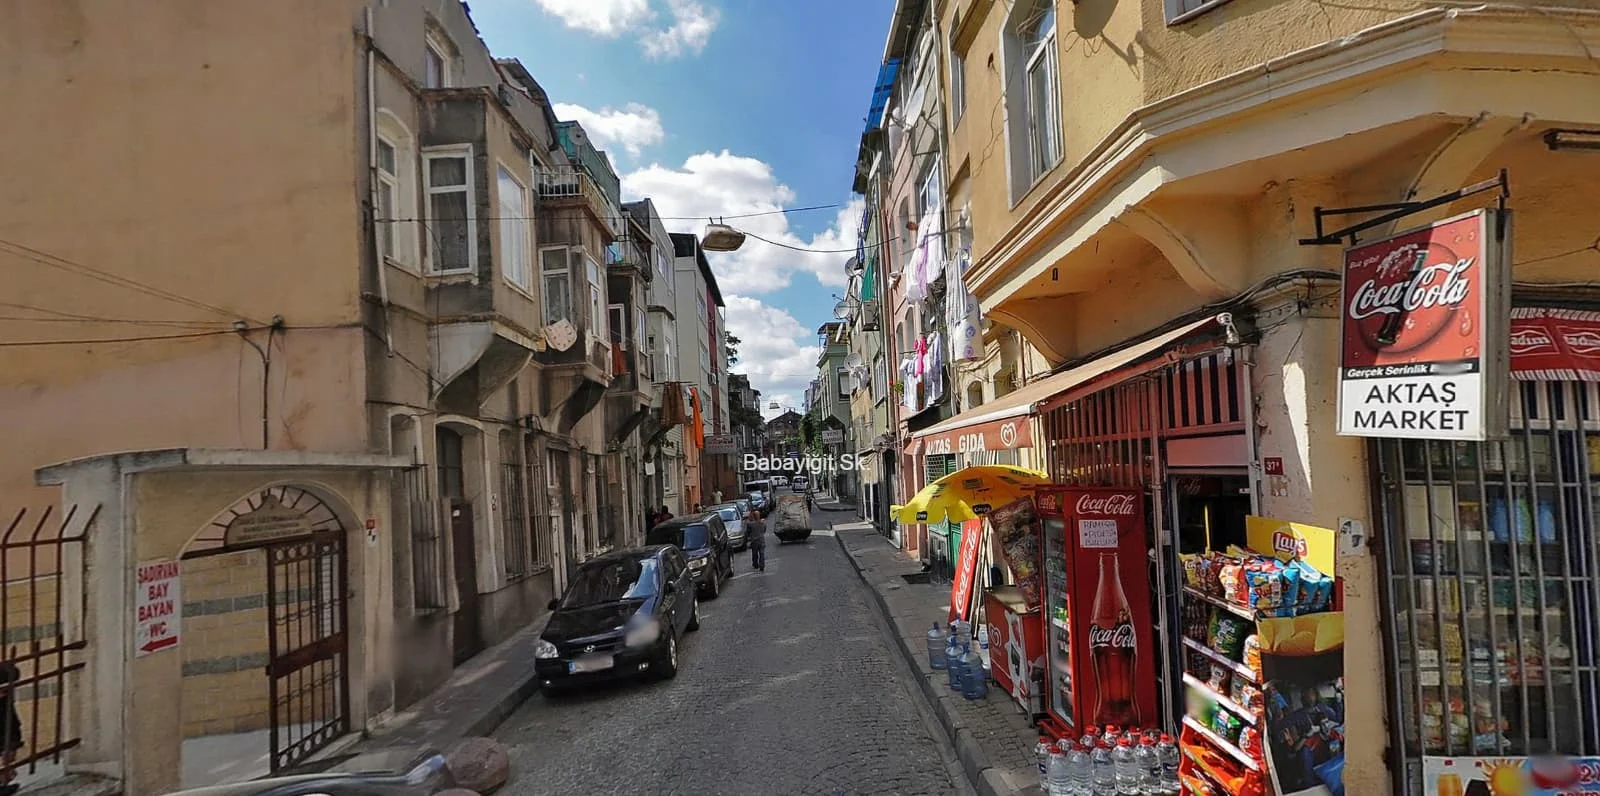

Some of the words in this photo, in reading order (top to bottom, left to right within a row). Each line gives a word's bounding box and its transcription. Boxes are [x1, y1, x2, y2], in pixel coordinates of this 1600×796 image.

[1347, 367, 1383, 378] Gerçek
[1385, 364, 1428, 376] Serinlik
[1365, 382, 1456, 408] AKTAŞ
[1354, 410, 1469, 430] MARKET
[959, 433, 986, 453] GIDA
[148, 583, 169, 601] BAY
[138, 600, 174, 622] BAYAN
[150, 621, 167, 637] WC
